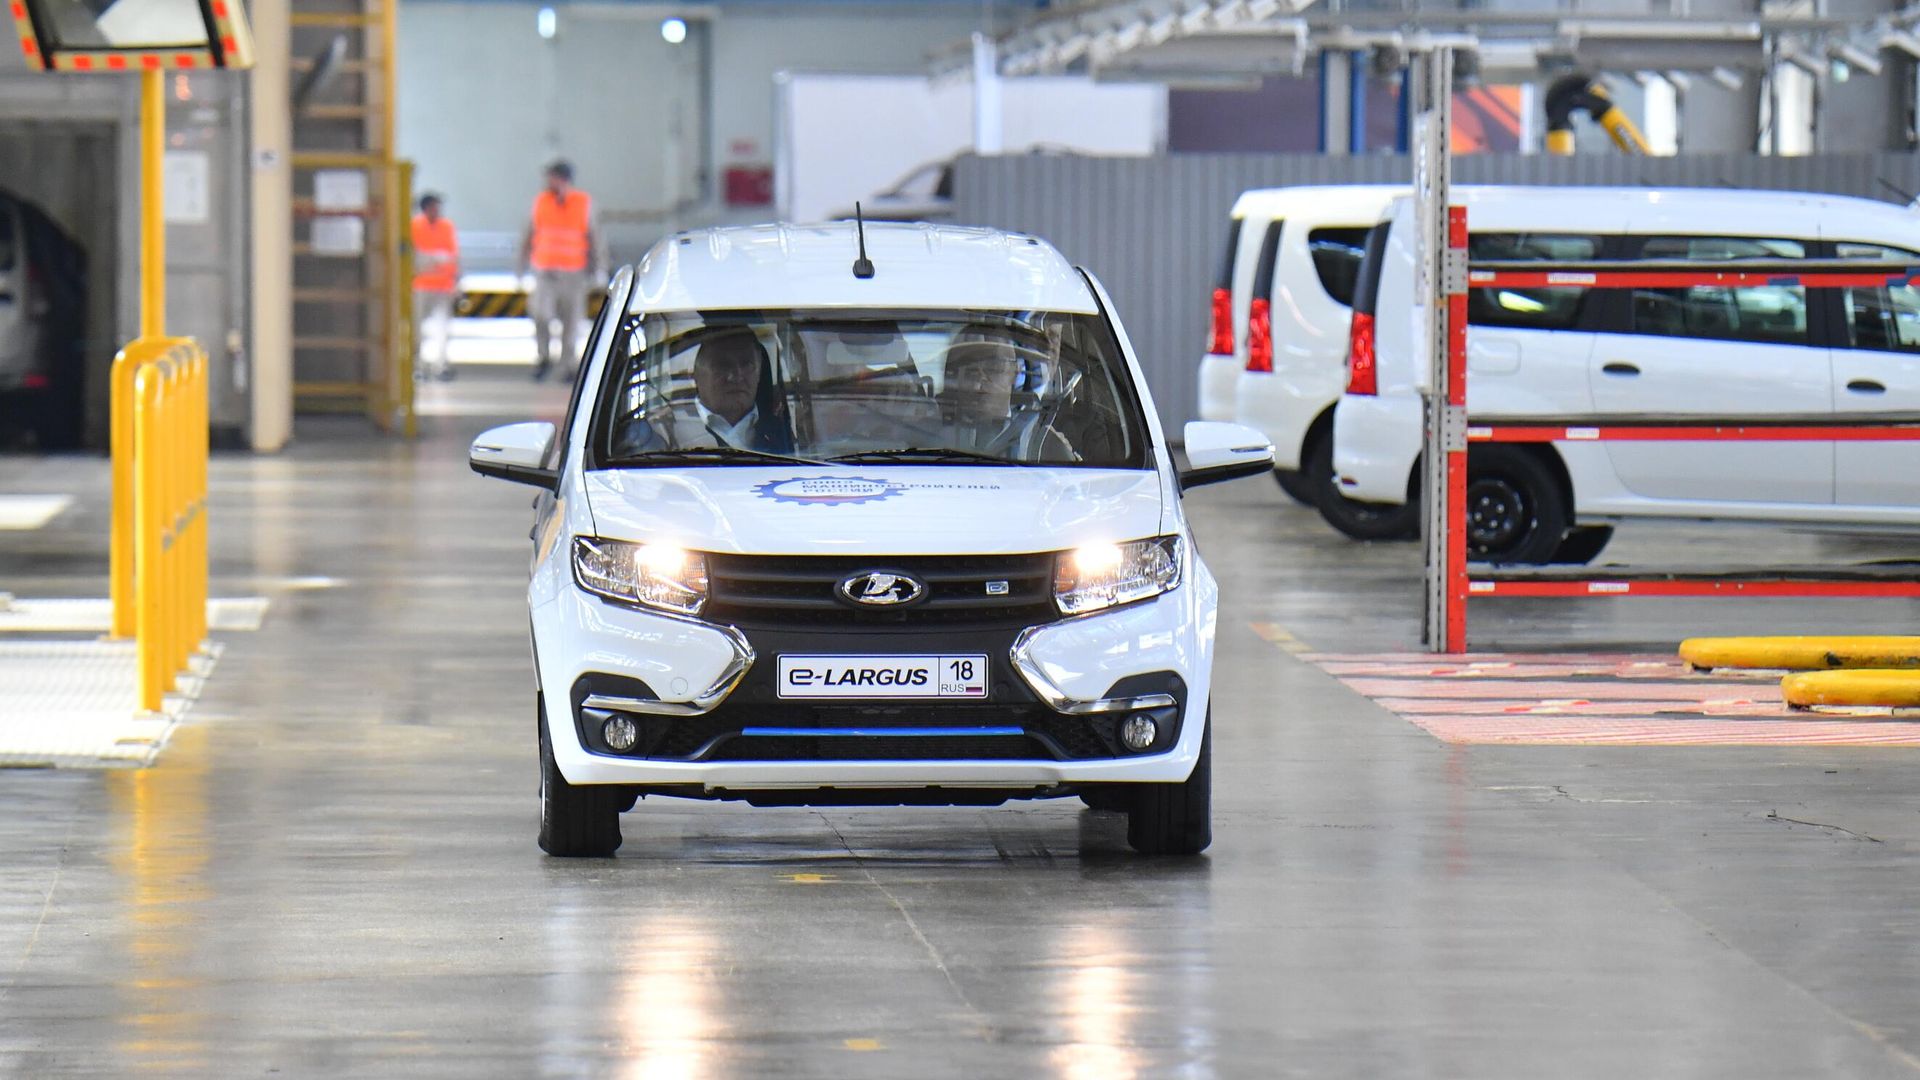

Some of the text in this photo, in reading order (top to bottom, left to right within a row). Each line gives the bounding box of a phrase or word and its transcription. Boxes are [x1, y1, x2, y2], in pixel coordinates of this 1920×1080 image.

[789, 668, 929, 686] e-LARGUS
[949, 660, 974, 681] 18
[941, 684, 965, 693] RUS
